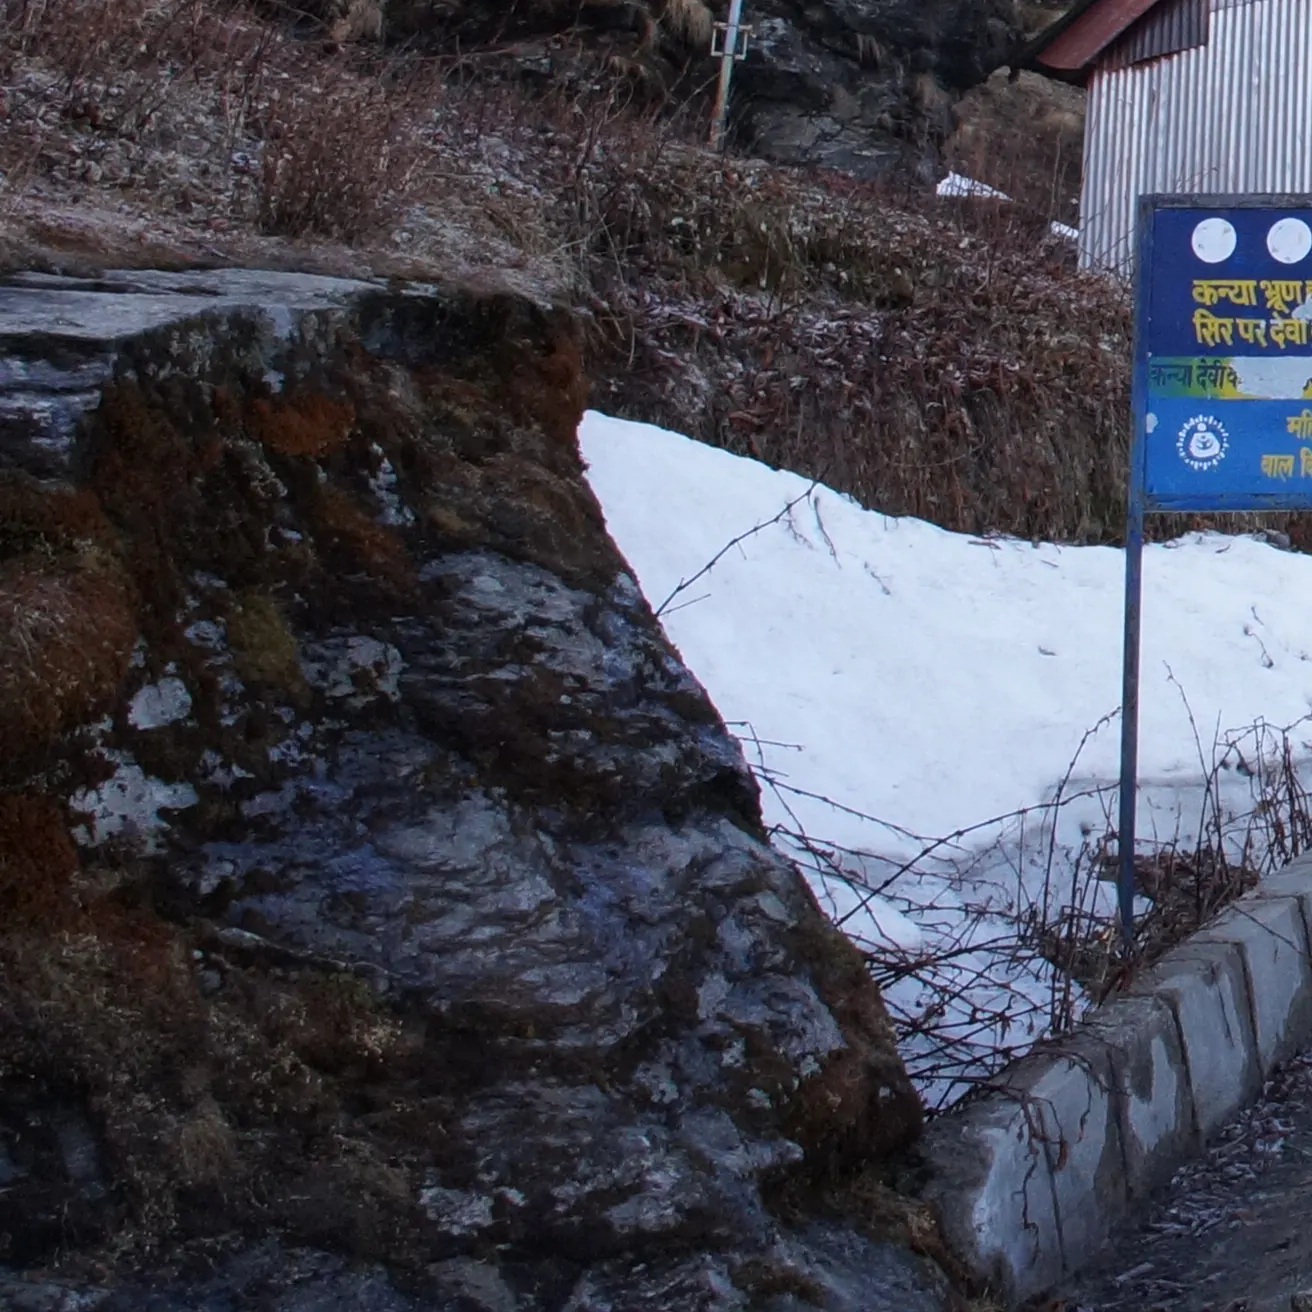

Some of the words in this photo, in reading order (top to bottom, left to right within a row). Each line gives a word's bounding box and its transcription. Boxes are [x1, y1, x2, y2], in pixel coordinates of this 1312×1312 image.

[1192, 280, 1257, 306] कन्या
[1260, 280, 1303, 314] भ्रूण
[1192, 308, 1234, 347] सिर
[1236, 318, 1267, 347] पर
[1150, 364, 1193, 389] कन्या
[1197, 359, 1227, 391] देवी
